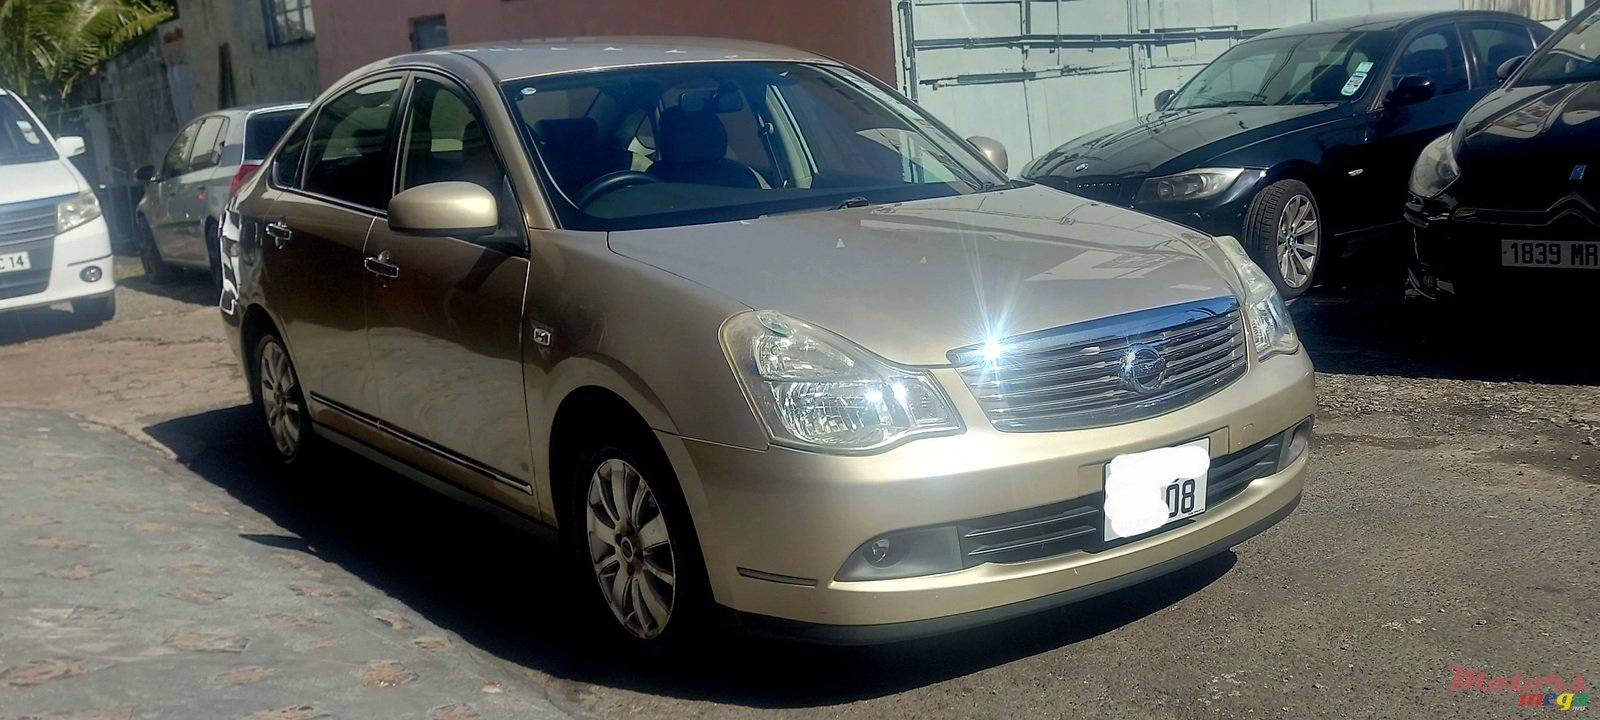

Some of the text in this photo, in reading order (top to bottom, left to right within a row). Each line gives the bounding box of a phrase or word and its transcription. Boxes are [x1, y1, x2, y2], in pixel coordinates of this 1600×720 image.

[9, 255, 24, 268] 14
[1510, 242, 1599, 266] 1839 MR
[1165, 478, 1196, 519] 08
